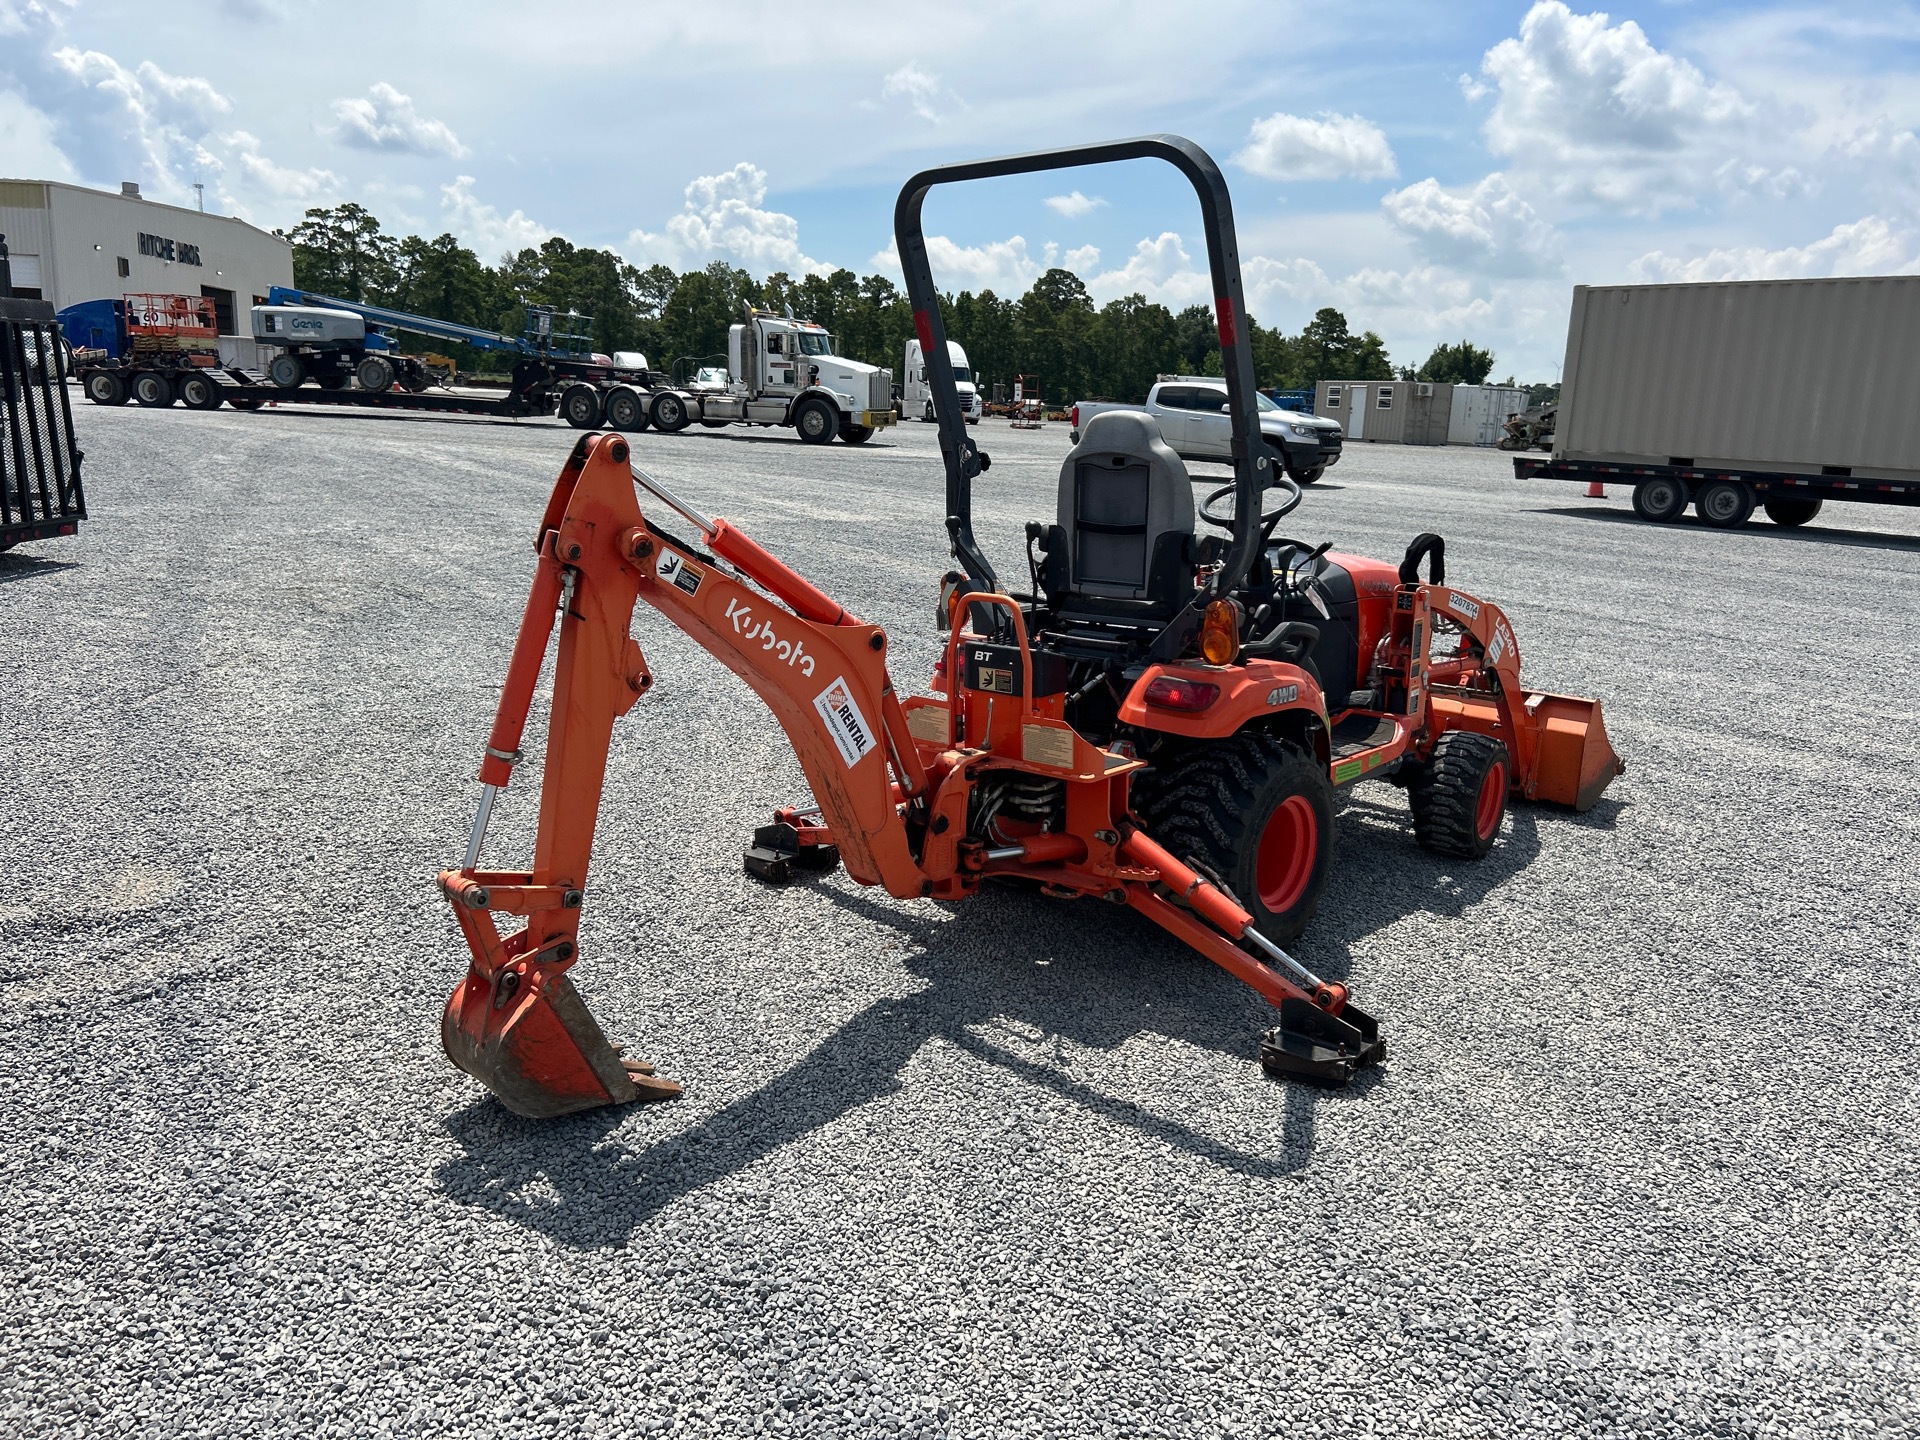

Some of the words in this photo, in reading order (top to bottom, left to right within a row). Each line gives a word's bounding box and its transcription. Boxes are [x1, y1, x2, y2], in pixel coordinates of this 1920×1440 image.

[137, 231, 175, 261] RITCHIE
[291, 318, 323, 329] Genie
[724, 597, 815, 678] Kubota
[974, 650, 993, 662] BT
[1266, 683, 1298, 706] 4WD
[838, 704, 867, 752] RENTAL
